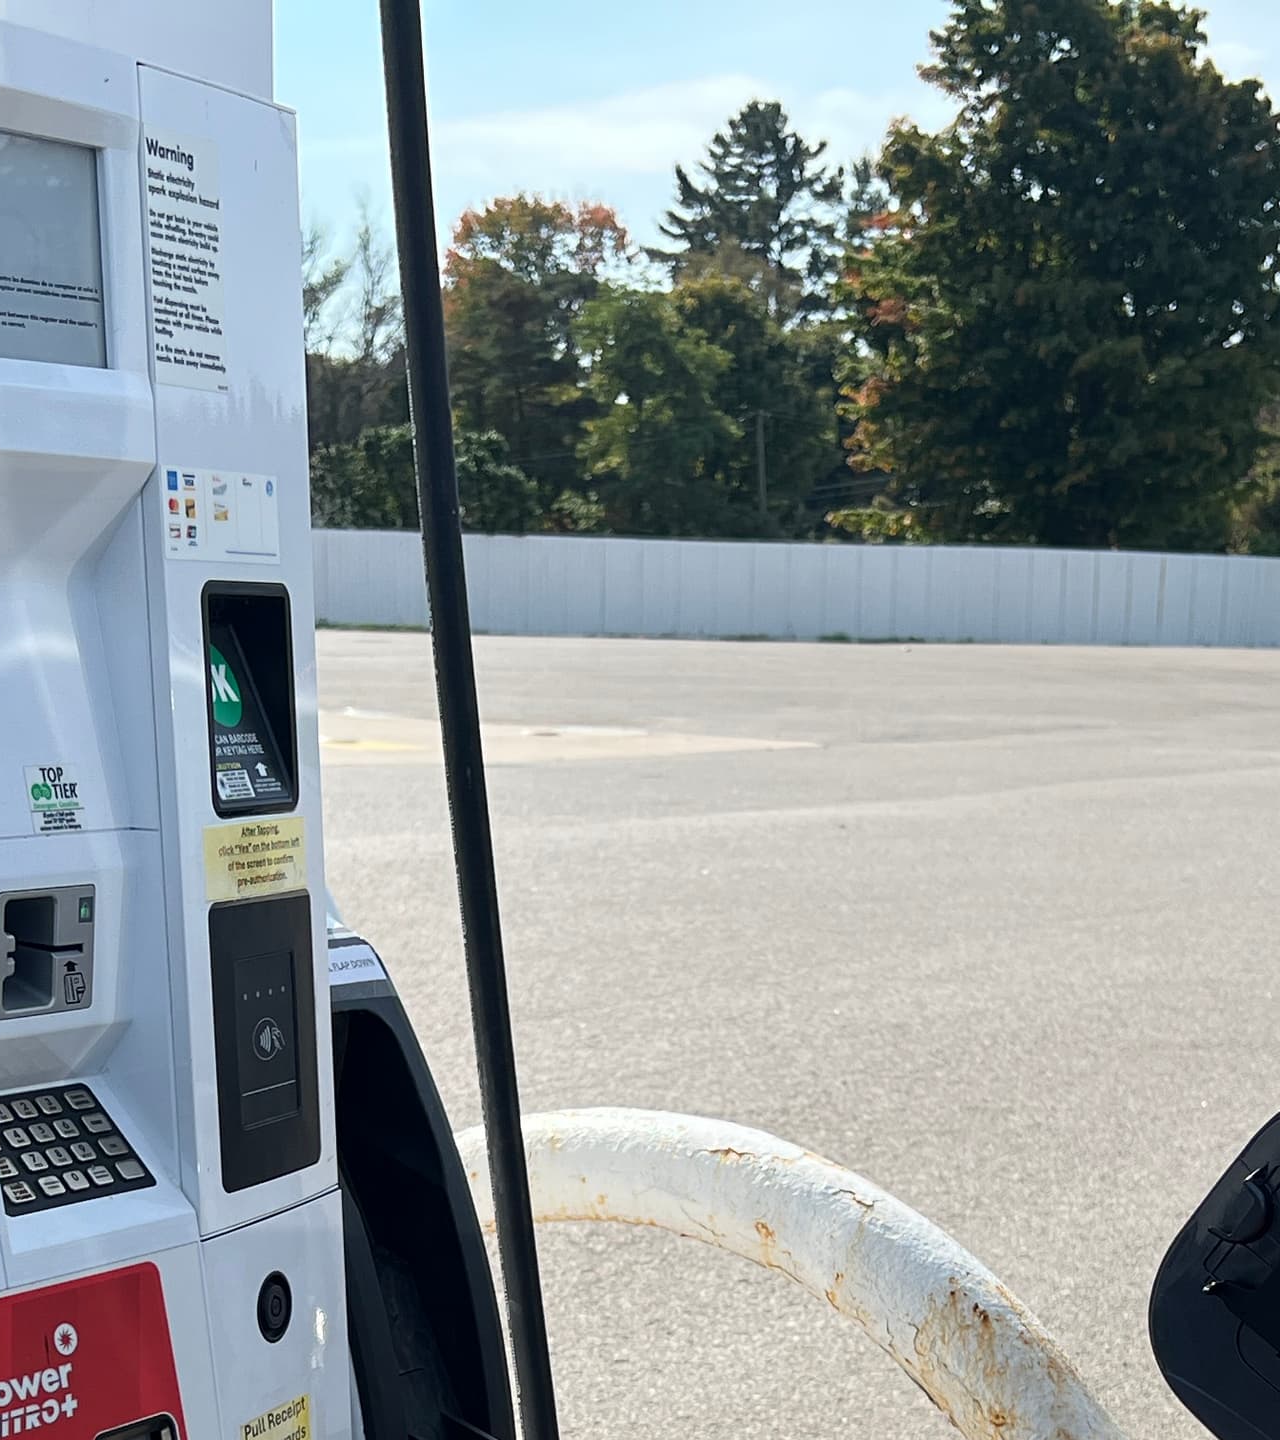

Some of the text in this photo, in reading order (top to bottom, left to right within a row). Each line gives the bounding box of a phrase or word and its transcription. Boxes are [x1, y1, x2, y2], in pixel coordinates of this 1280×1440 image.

[146, 137, 194, 171] Warning
[211, 664, 240, 703] K
[228, 733, 258, 743] BARCODE
[247, 744, 264, 755] HERE
[39, 767, 63, 783] TOP
[51, 782, 78, 799] TIER
[241, 826, 256, 837] After
[218, 845, 234, 856] click
[253, 844, 260, 852] on
[261, 842, 270, 851] the
[271, 840, 289, 850] bottom
[228, 854, 294, 871] of the screen to confirm
[20, 1102, 30, 1112] 2
[12, 1130, 21, 1139] 4
[28, 1154, 37, 1164] 7
[267, 1396, 306, 1427] Receipt
